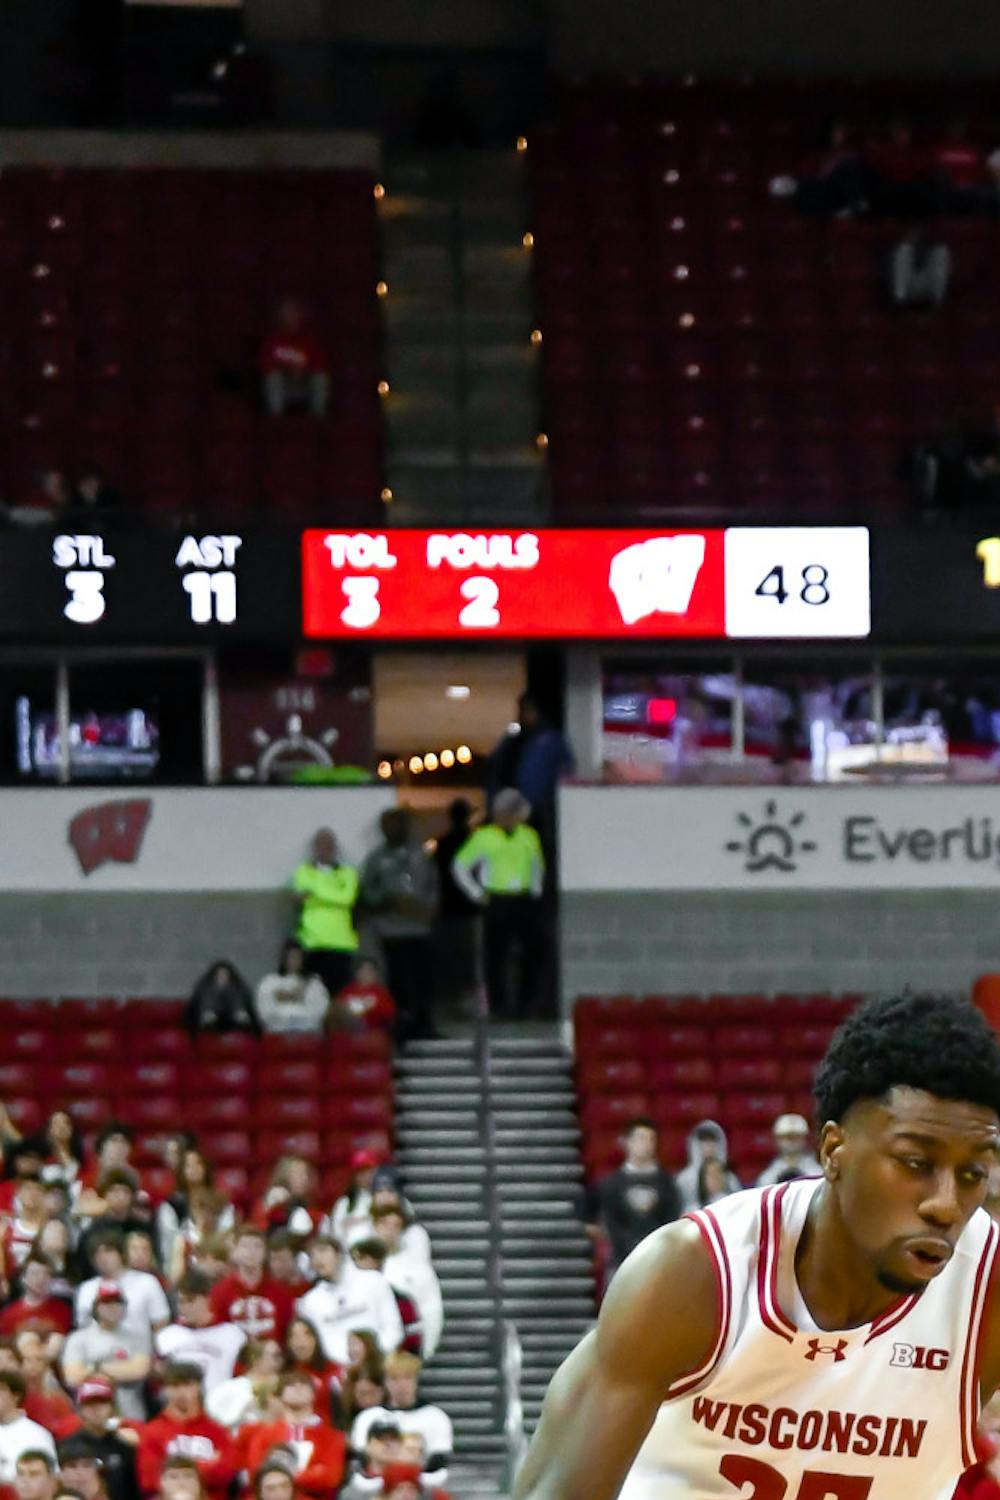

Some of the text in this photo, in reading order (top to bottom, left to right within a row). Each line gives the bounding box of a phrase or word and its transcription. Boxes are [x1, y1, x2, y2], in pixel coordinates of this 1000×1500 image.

[52, 534, 116, 568] STL
[175, 534, 243, 568] AST
[323, 533, 398, 569] TOL
[426, 533, 540, 569] FOULS
[64, 570, 106, 623] 3
[182, 570, 237, 624] 11
[340, 575, 381, 628] 3
[458, 575, 500, 628] 2
[755, 563, 831, 606] 48
[889, 1342, 950, 1370] BIG
[691, 1395, 928, 1458] WISCONSIN
